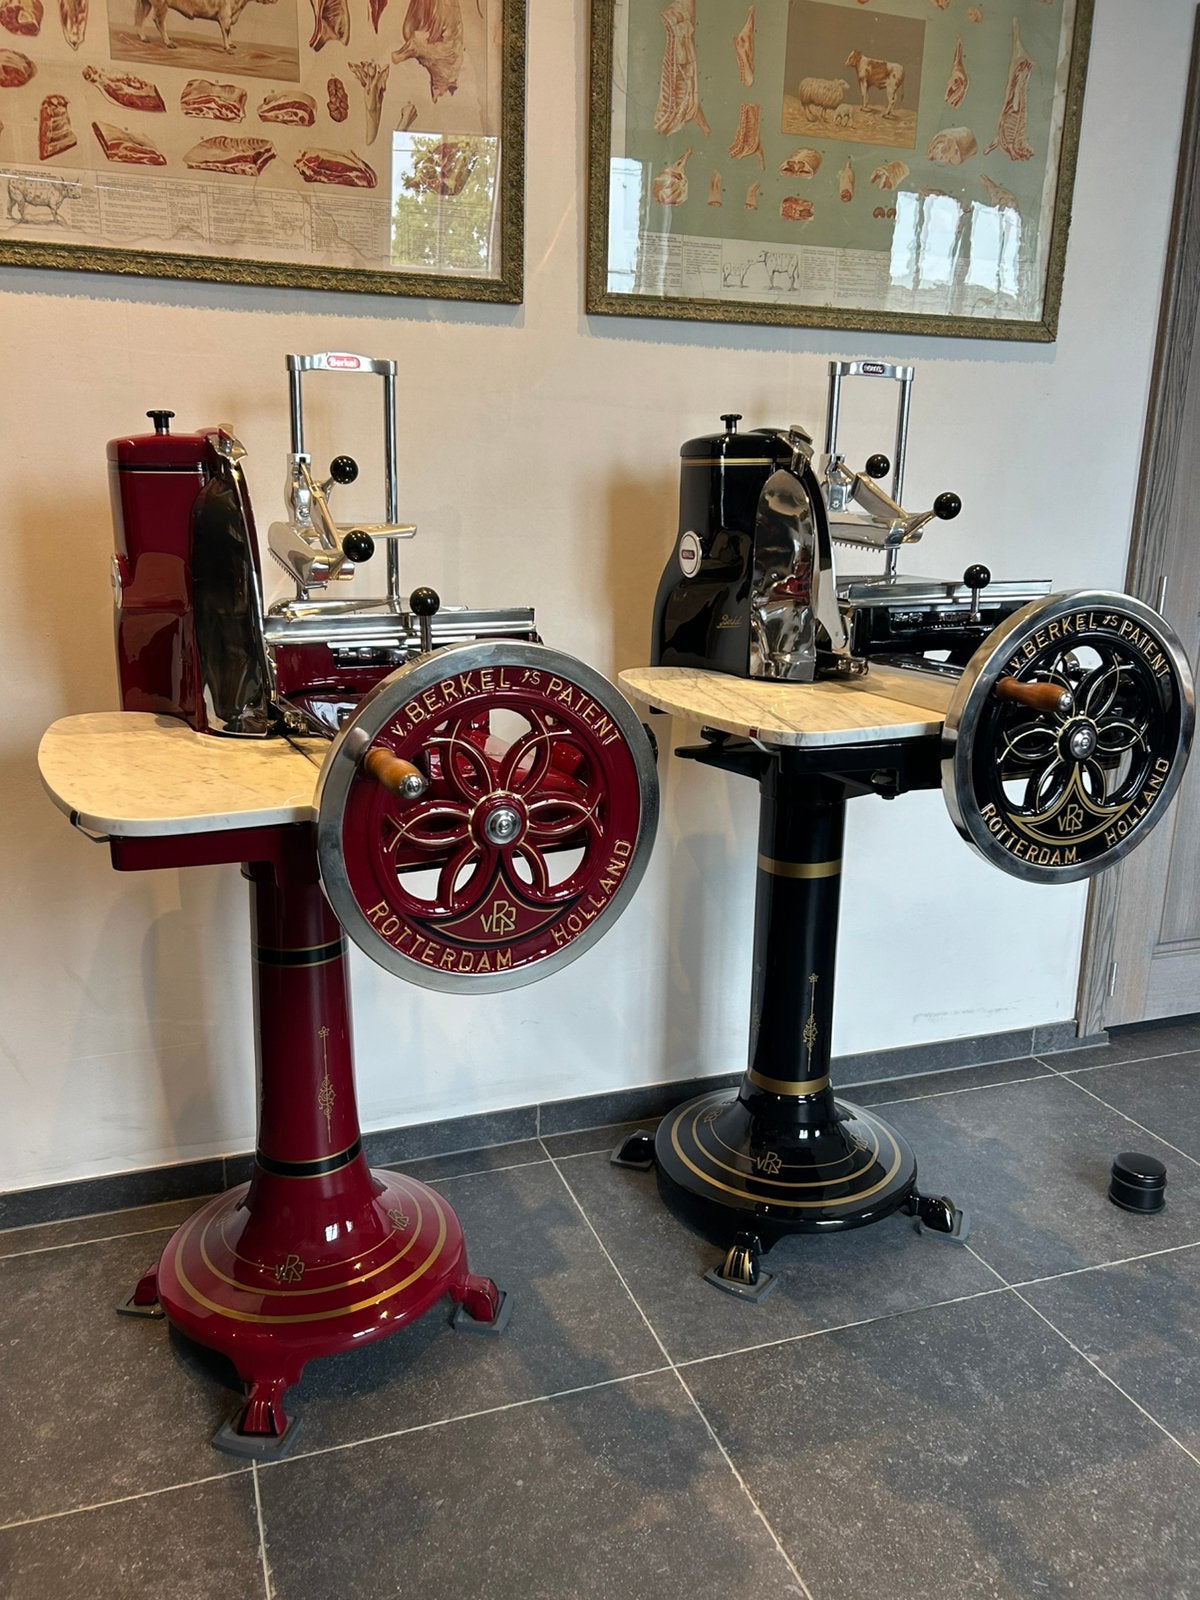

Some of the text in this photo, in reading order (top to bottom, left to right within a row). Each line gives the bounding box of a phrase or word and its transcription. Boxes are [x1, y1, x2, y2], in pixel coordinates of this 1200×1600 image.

[1119, 619, 1171, 678] PATENT
[546, 677, 622, 746] PATENT
[980, 757, 1169, 866] ROTTERDAM HOLLAND
[366, 840, 632, 971] ROTTERDAM HOLLAND
